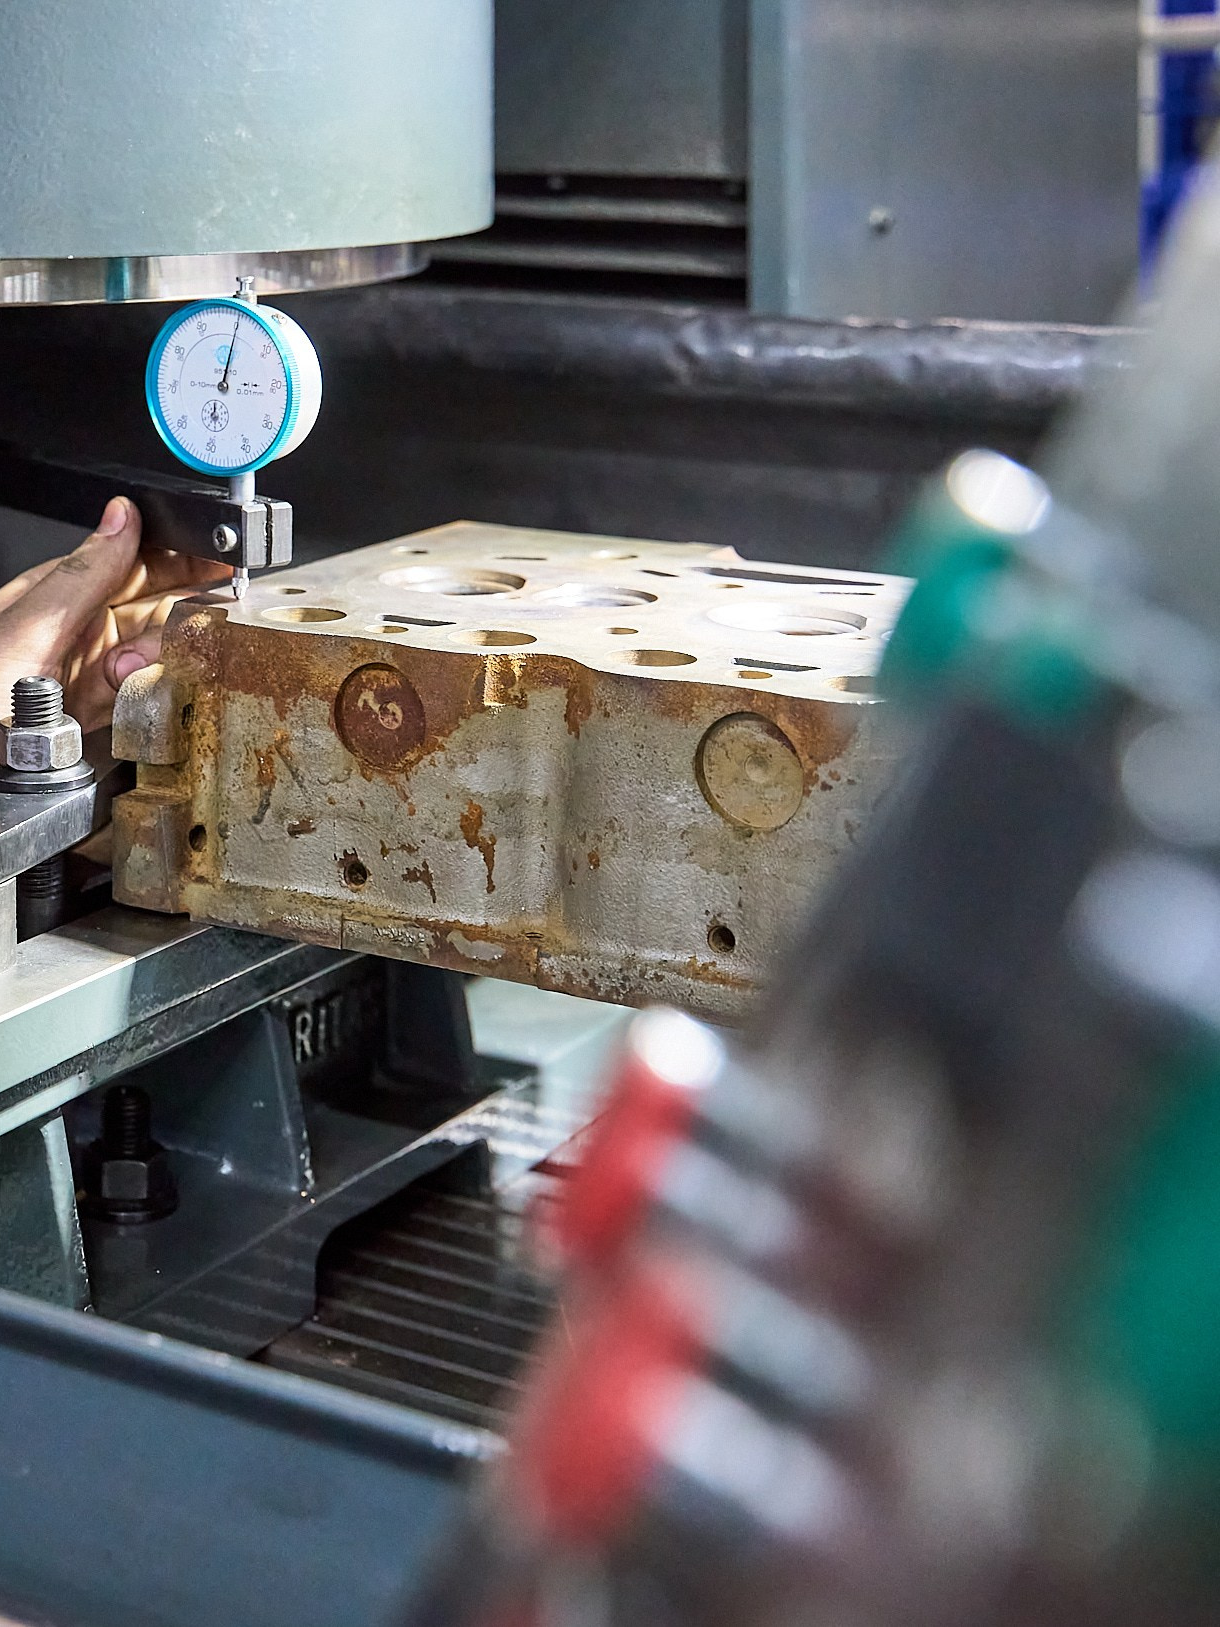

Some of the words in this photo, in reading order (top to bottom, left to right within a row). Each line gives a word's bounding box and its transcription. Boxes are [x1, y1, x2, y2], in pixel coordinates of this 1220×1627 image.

[197, 321, 207, 332] 90
[175, 345, 185, 356] 80
[263, 344, 271, 354] 10
[167, 384, 177, 394] 70
[271, 379, 281, 389] 20
[236, 388, 265, 396] 0.01mm
[176, 419, 187, 429] 60
[262, 420, 273, 430] 30
[206, 442, 216, 453] 50
[240, 443, 251, 453] 40
